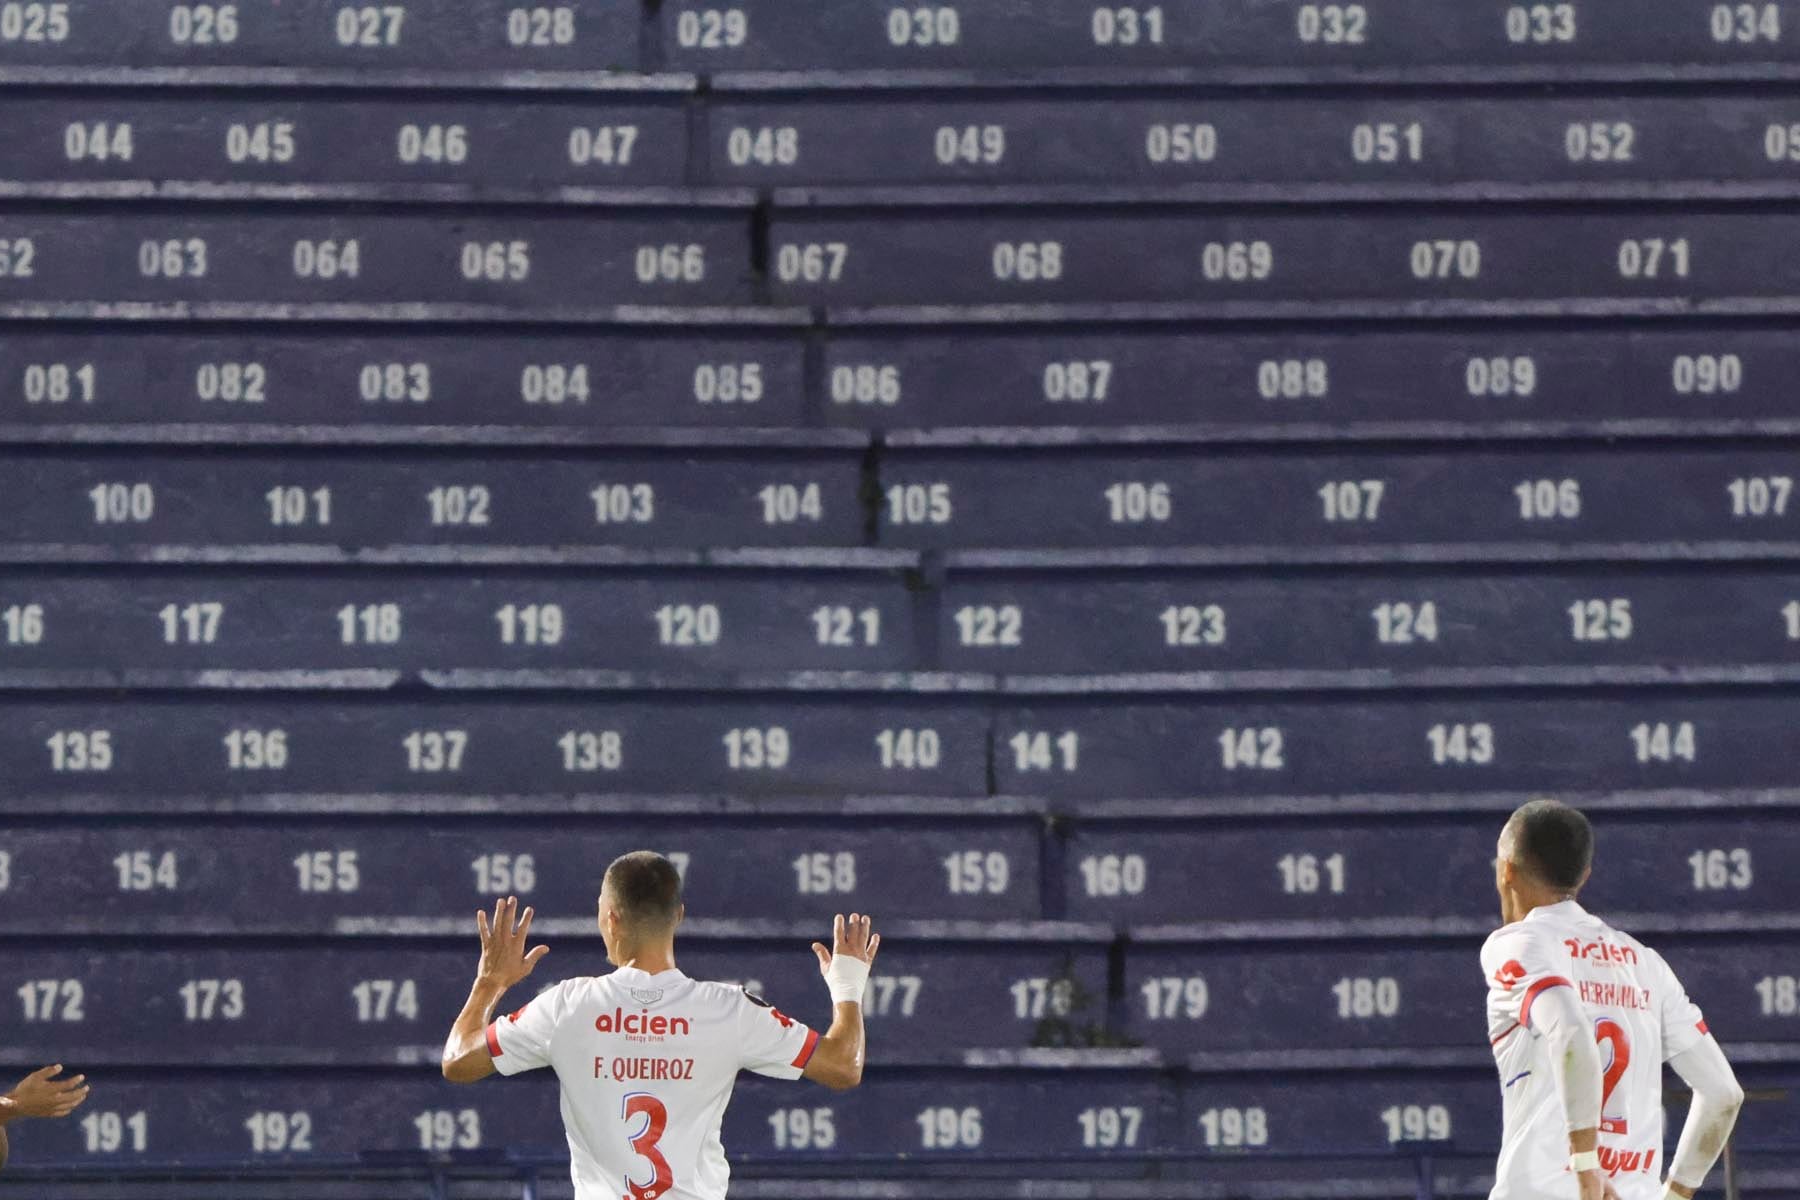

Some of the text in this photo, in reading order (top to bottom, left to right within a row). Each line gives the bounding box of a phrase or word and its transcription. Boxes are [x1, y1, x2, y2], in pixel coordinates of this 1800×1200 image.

[0, 3, 69, 41] 025
[336, 6, 405, 46] 027
[508, 7, 575, 46] 028
[887, 7, 959, 45] 030
[1092, 6, 1163, 44] 031
[1298, 4, 1367, 44] 032
[1710, 3, 1780, 42] 034
[64, 122, 133, 161] 044
[226, 122, 295, 162] 045
[398, 124, 468, 163] 046
[727, 126, 798, 166] 048
[935, 125, 1005, 164] 049
[1352, 122, 1423, 162] 051
[1565, 121, 1635, 161] 052
[139, 237, 207, 277] 063
[293, 239, 359, 278] 064
[635, 244, 704, 282] 066
[777, 242, 848, 282] 067
[1202, 240, 1273, 281] 069
[1410, 240, 1481, 278] 070
[24, 363, 95, 402] 081
[359, 362, 430, 402] 083
[521, 364, 590, 404] 084
[830, 365, 901, 404] 086
[1043, 360, 1112, 401] 087
[1466, 356, 1536, 396] 089
[1672, 354, 1742, 393] 090
[89, 483, 154, 523] 100
[266, 486, 331, 525] 101
[590, 483, 654, 523] 103
[758, 482, 822, 524] 104
[1104, 482, 1171, 523] 106
[1318, 479, 1385, 521] 107
[1514, 478, 1581, 520] 106
[336, 603, 401, 644] 118
[495, 603, 564, 645] 119
[654, 604, 721, 646] 120
[954, 604, 1022, 646] 122
[1159, 604, 1226, 646] 123
[1567, 598, 1633, 641] 125
[46, 729, 113, 771] 135
[223, 728, 288, 769] 136
[402, 729, 468, 771] 137
[722, 726, 790, 769] 139
[876, 728, 940, 769] 140
[1217, 727, 1284, 770] 142
[1426, 722, 1495, 764] 143
[112, 850, 178, 891] 154
[293, 849, 360, 892] 155
[792, 851, 857, 894] 158
[943, 850, 1010, 894] 159
[1277, 853, 1345, 893] 161
[1687, 847, 1753, 890] 163
[17, 978, 84, 1021] 172
[179, 978, 244, 1021] 173
[351, 979, 418, 1022] 174
[1331, 977, 1400, 1019] 180
[595, 1007, 689, 1035] alcien
[594, 1056, 694, 1083] F. QUEIROZ
[1595, 1017, 1630, 1134] 2
[80, 1110, 147, 1153] 191
[245, 1111, 312, 1153] 192
[768, 1106, 837, 1149] 195
[916, 1106, 983, 1148] 196
[1077, 1106, 1143, 1148] 197
[1380, 1104, 1451, 1144] 199
[622, 1092, 673, 1200] 3
